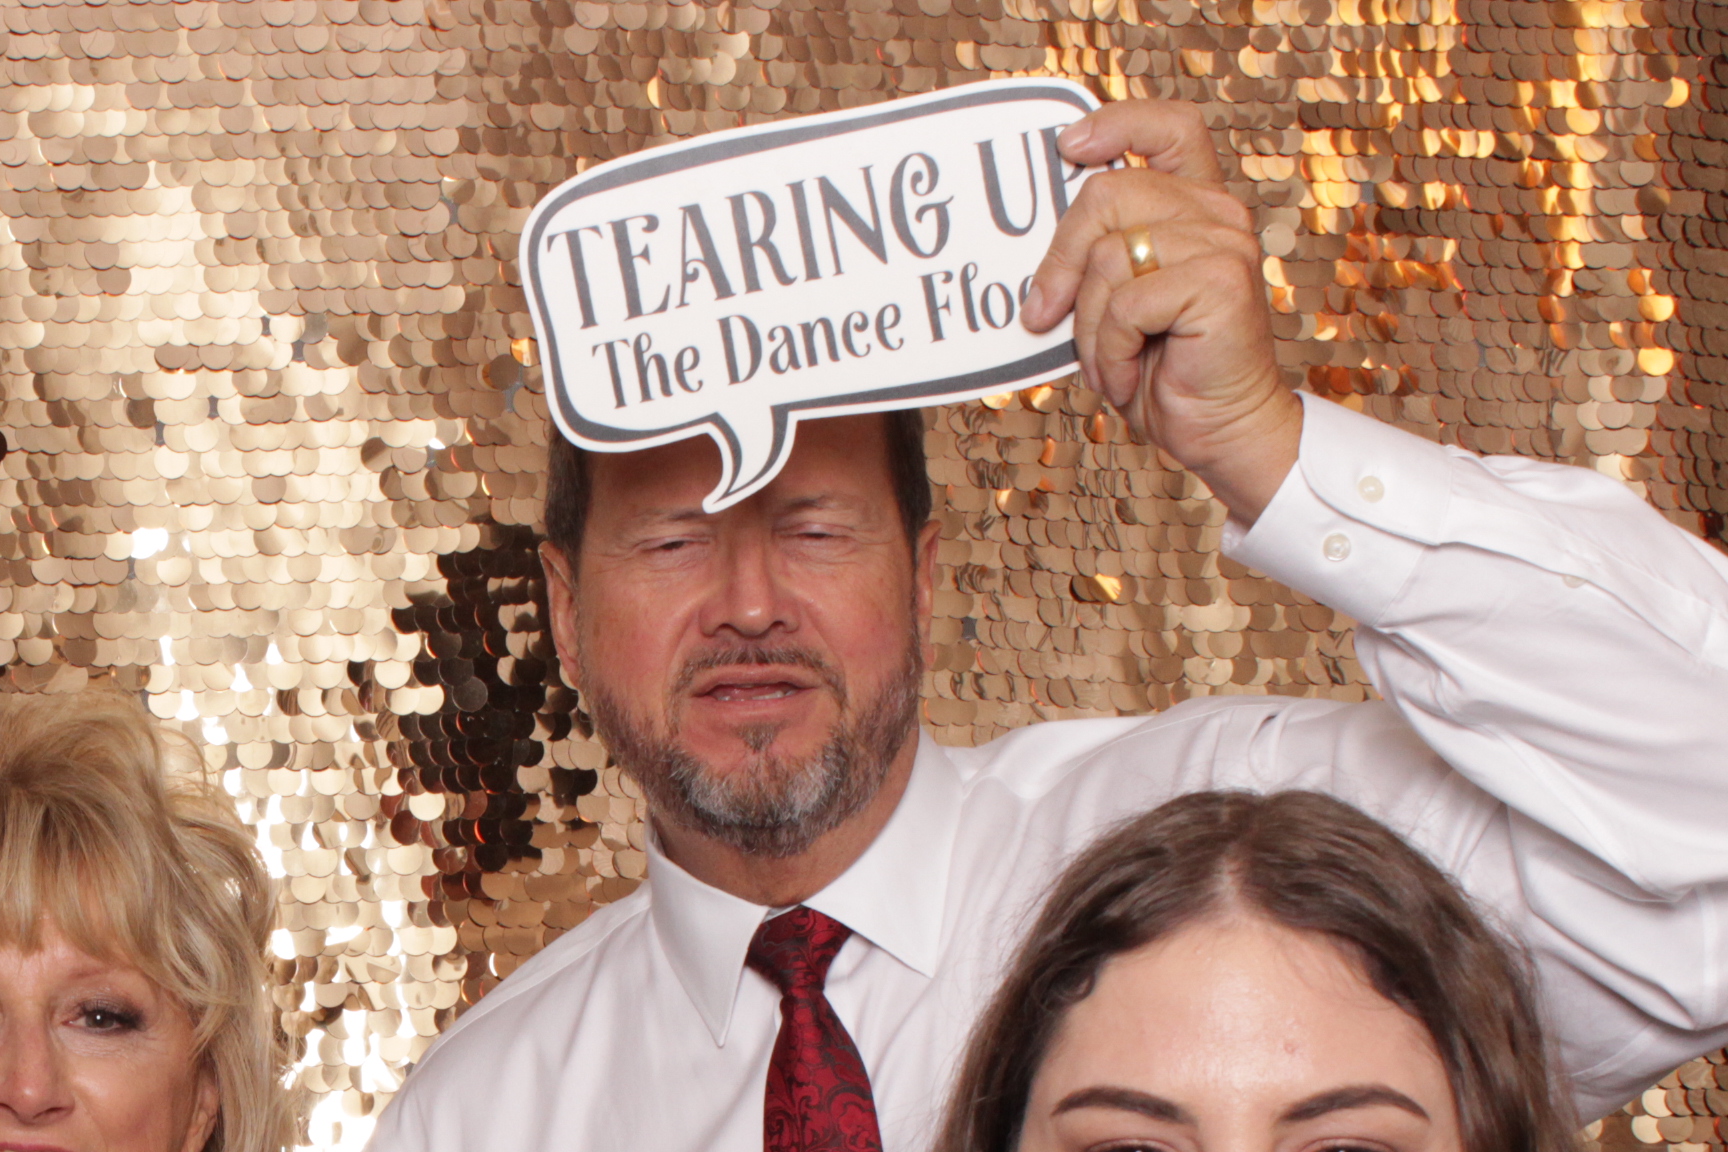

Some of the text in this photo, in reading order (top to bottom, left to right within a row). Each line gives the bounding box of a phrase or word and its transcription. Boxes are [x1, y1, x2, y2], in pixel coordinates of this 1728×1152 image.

[546, 152, 955, 330] TEARING
[592, 261, 1035, 410] The Dance Flo
